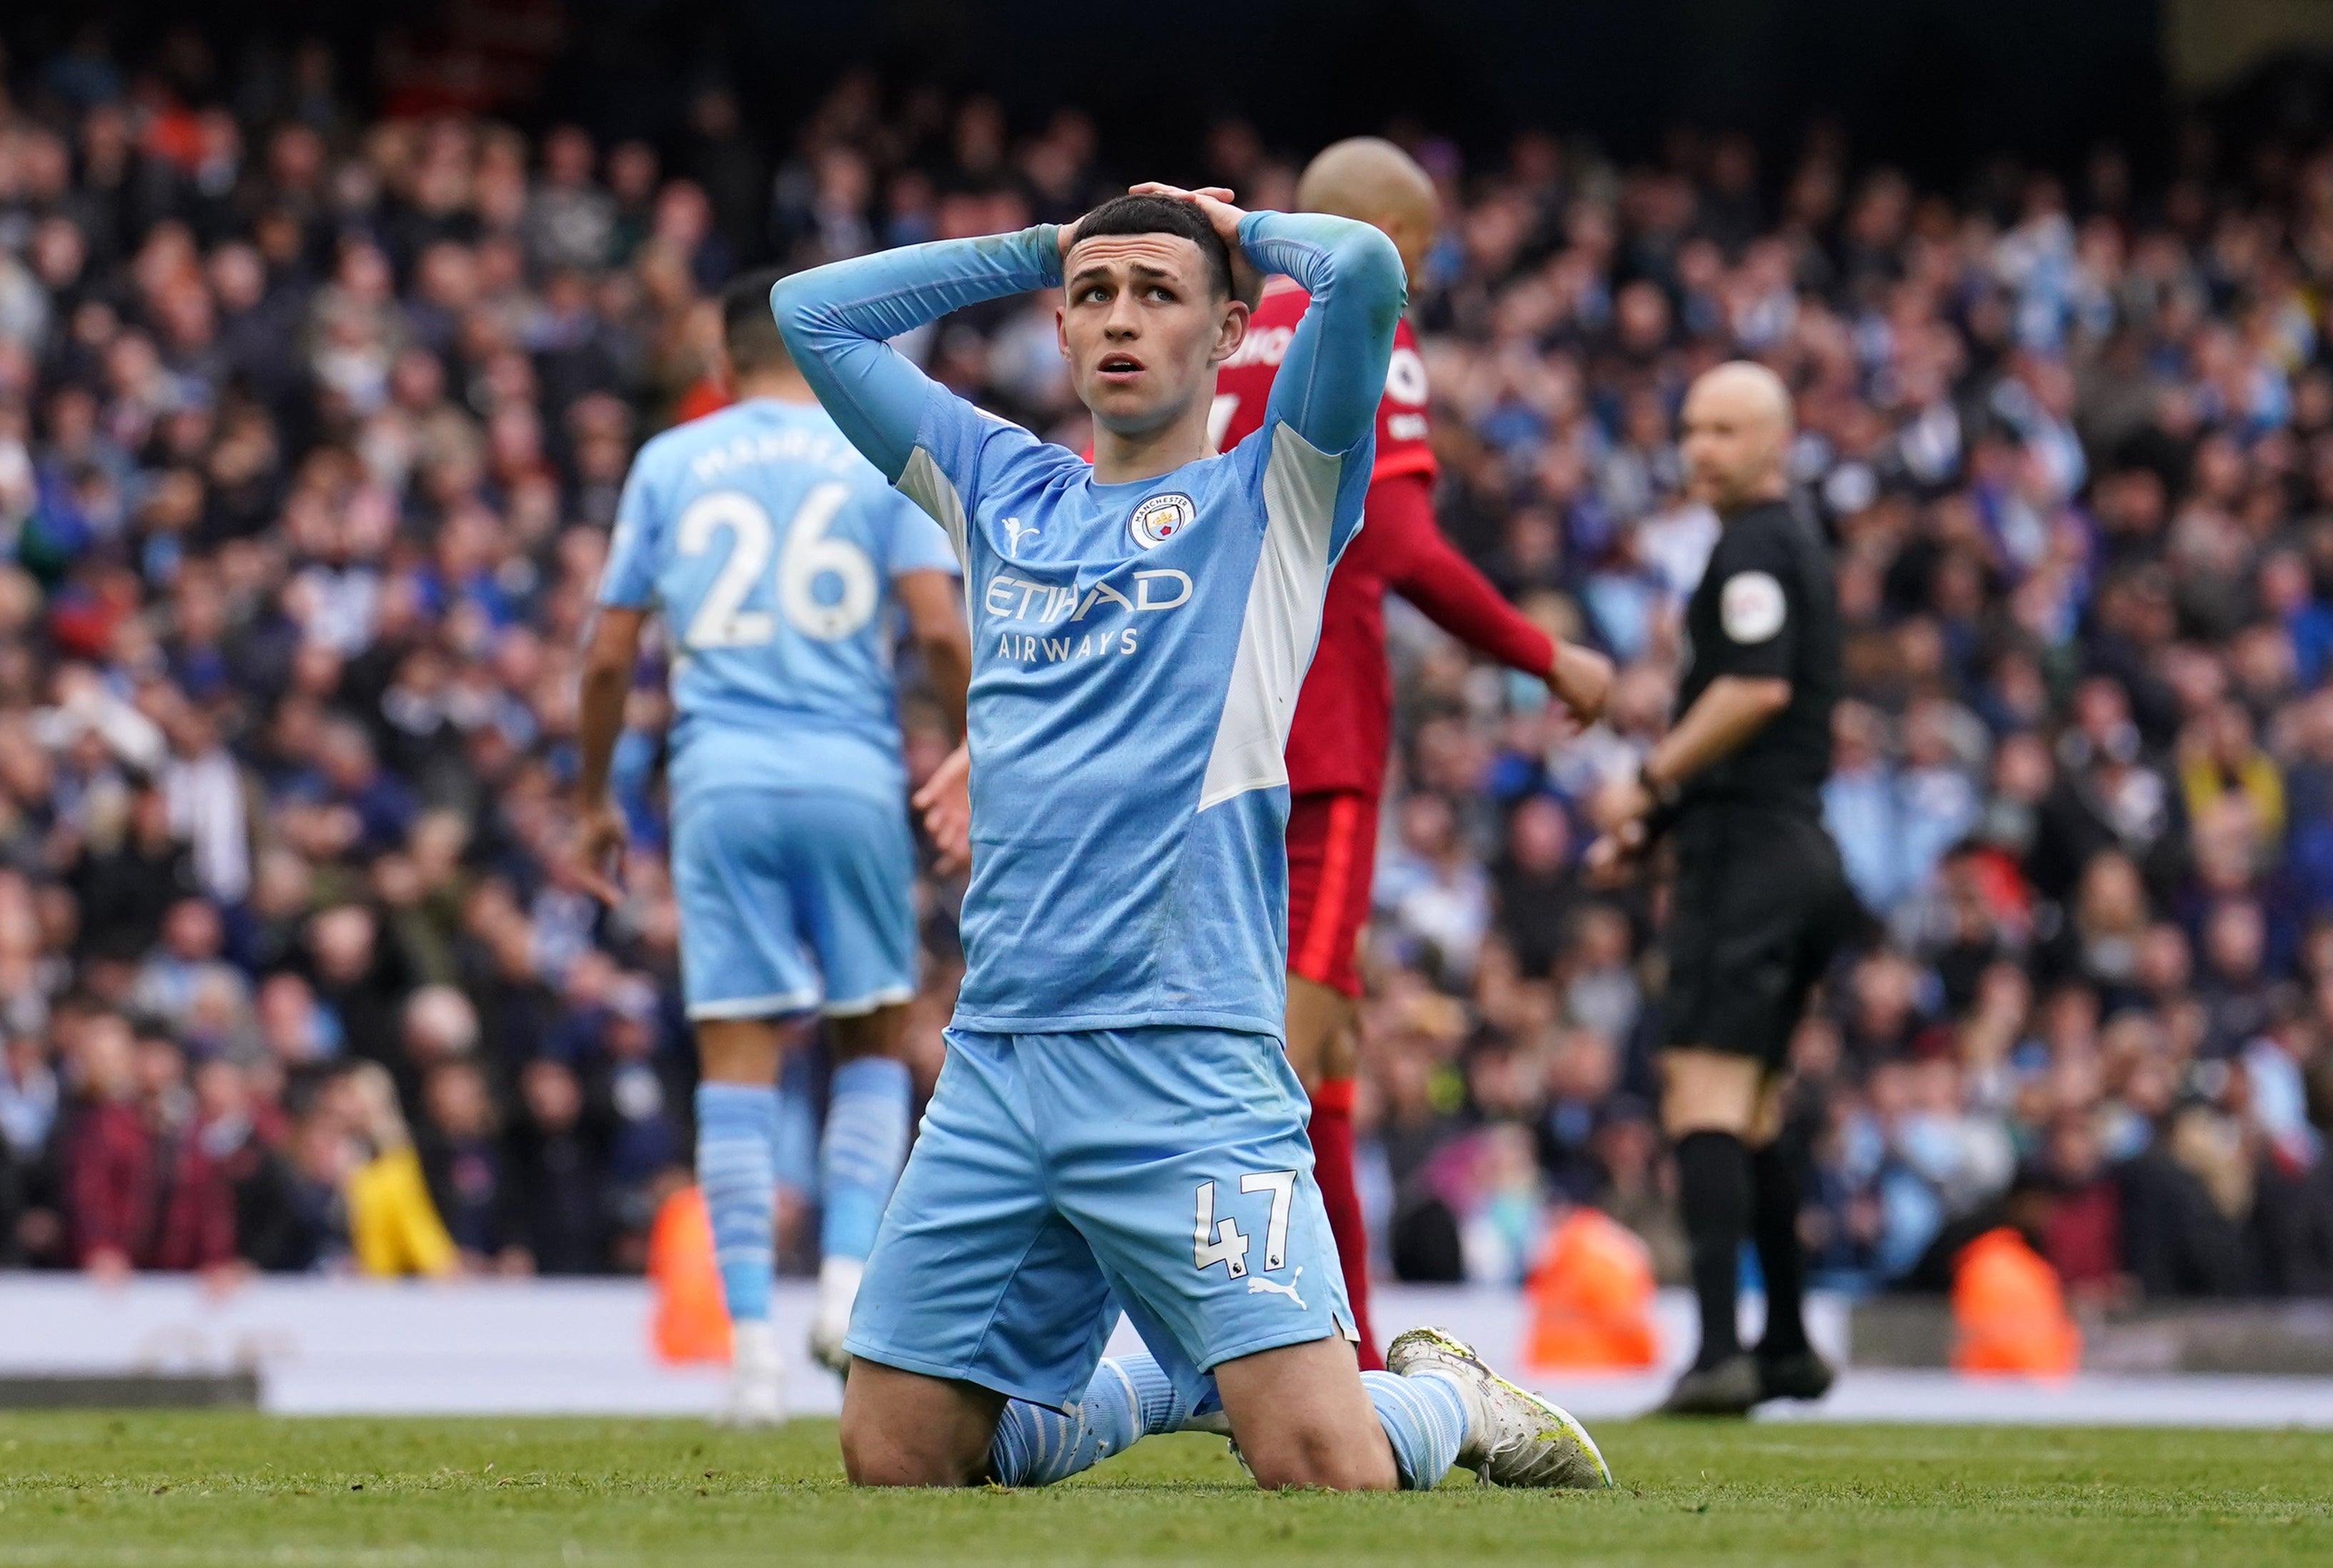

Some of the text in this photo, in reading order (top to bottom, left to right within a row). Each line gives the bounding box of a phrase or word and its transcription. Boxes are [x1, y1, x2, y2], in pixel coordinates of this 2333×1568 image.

[1135, 497, 1188, 522] MANCHESTER
[676, 482, 879, 650] 26
[986, 569, 1193, 622] ETIHAD
[999, 628, 1138, 662] AIRWAYS
[1193, 1169, 1298, 1280] 47
